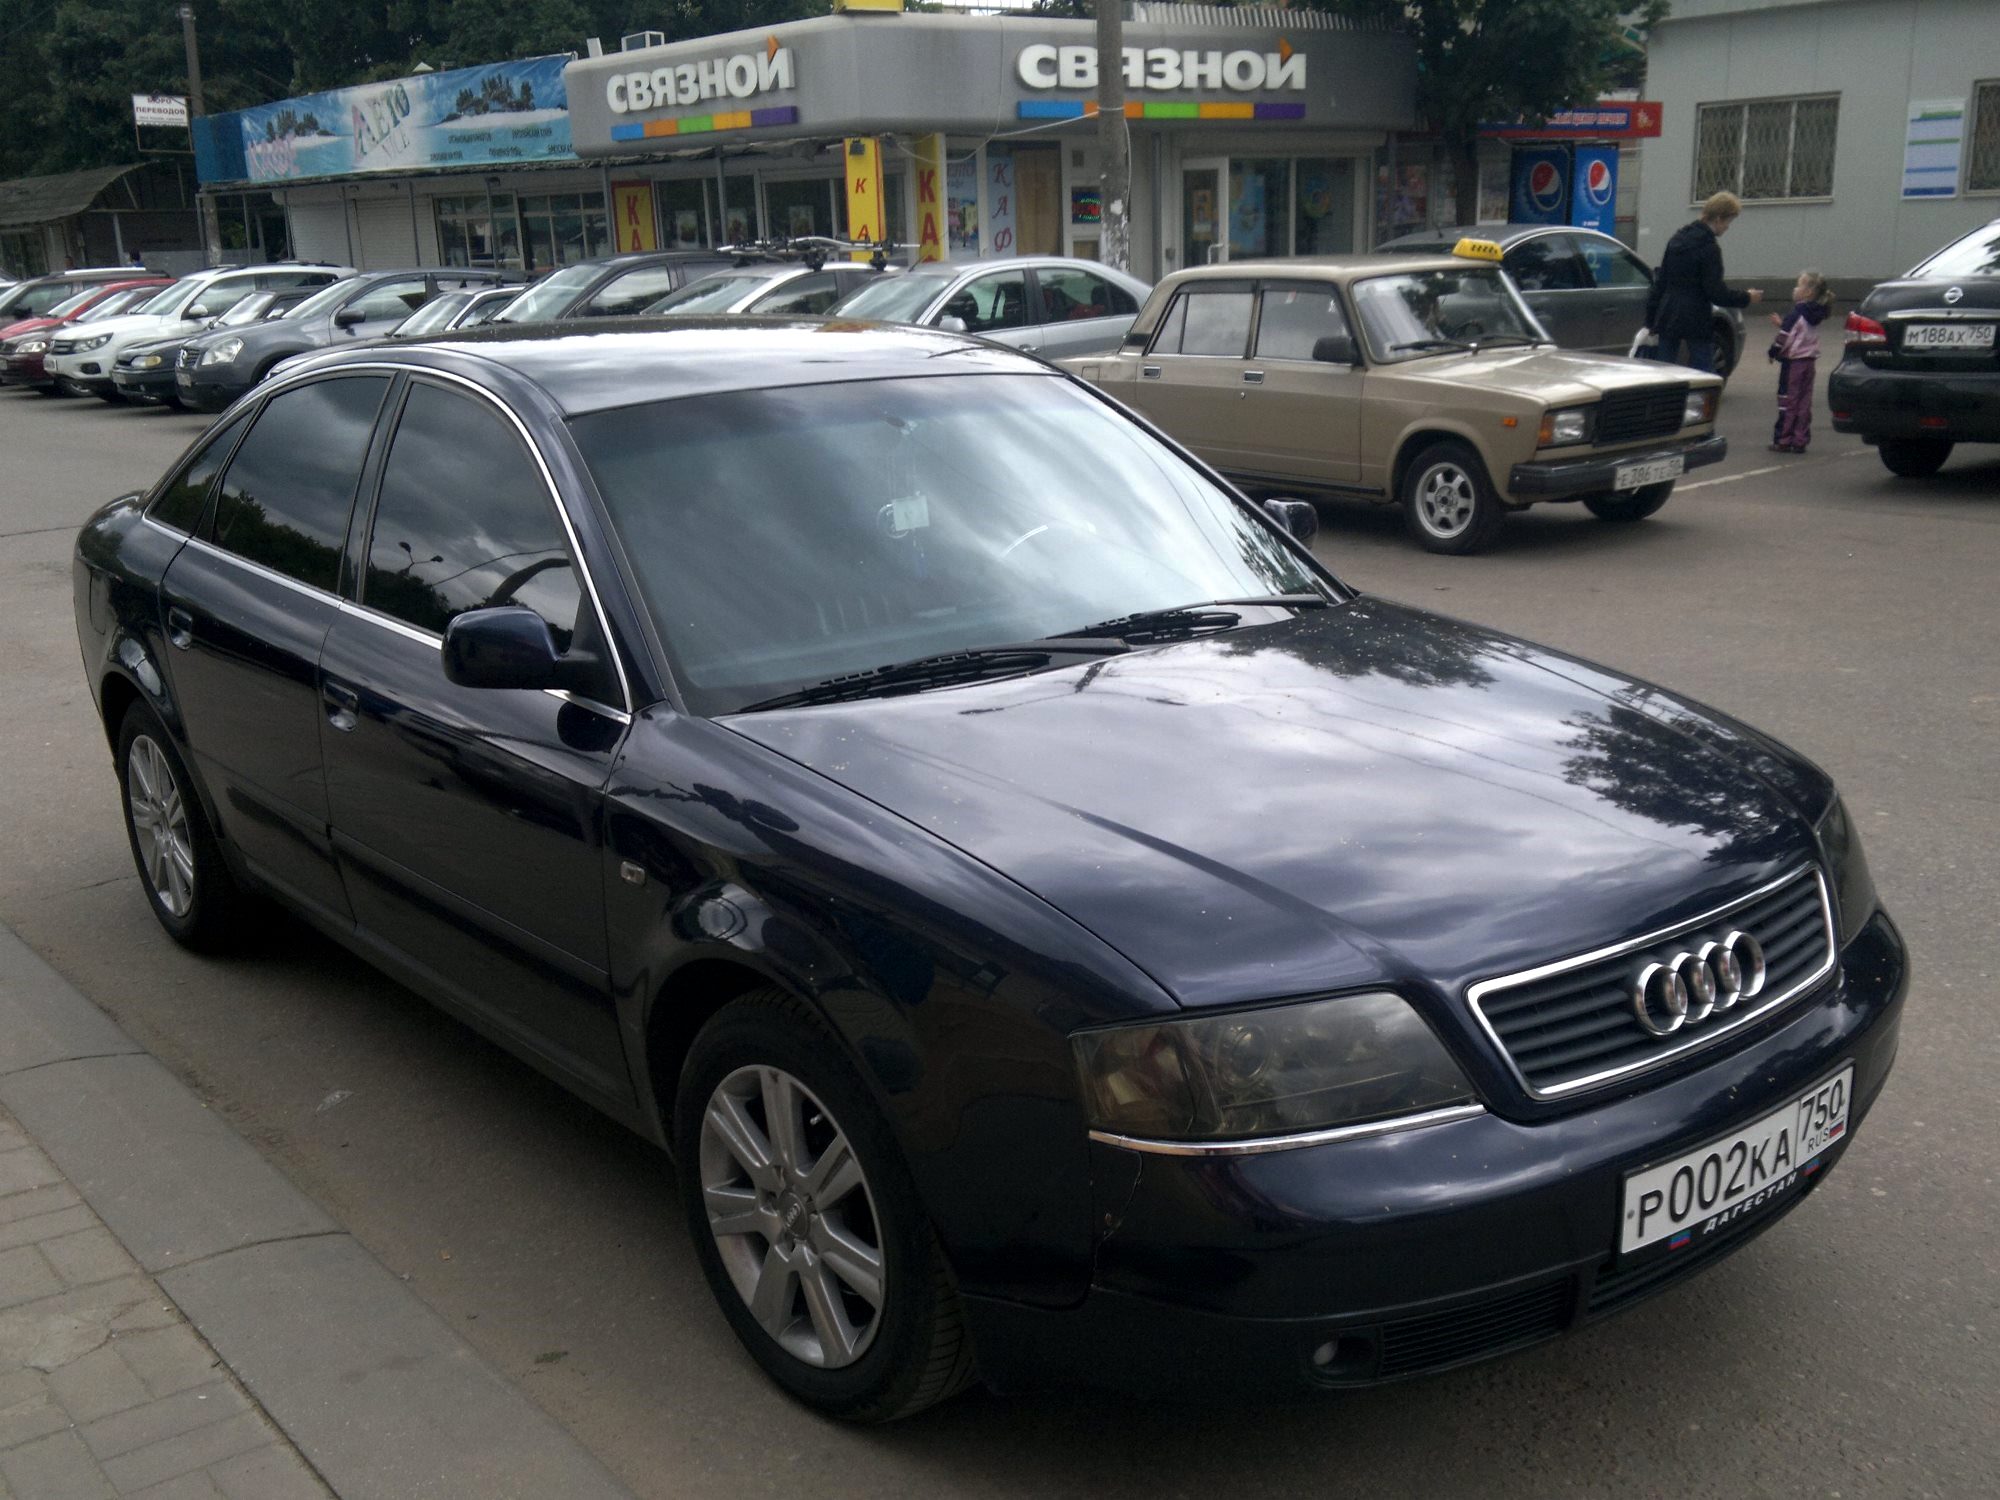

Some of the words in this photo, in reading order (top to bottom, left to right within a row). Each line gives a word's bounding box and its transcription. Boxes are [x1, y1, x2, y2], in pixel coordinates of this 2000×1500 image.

[607, 35, 795, 113] СВЯЗНОЙ
[1018, 36, 1307, 90] СВЯЗНОЙ
[136, 106, 185, 115] ПЕРЕВОДОВ
[918, 169, 940, 263] КА
[1908, 328, 1965, 343] М188АХ
[1968, 326, 1992, 340] 750
[1638, 1127, 1790, 1238] Р002КА
[1801, 1078, 1844, 1141] 750
[1808, 1127, 1830, 1153] RUS
[1703, 1171, 1798, 1234] ДАГЕСТАН
